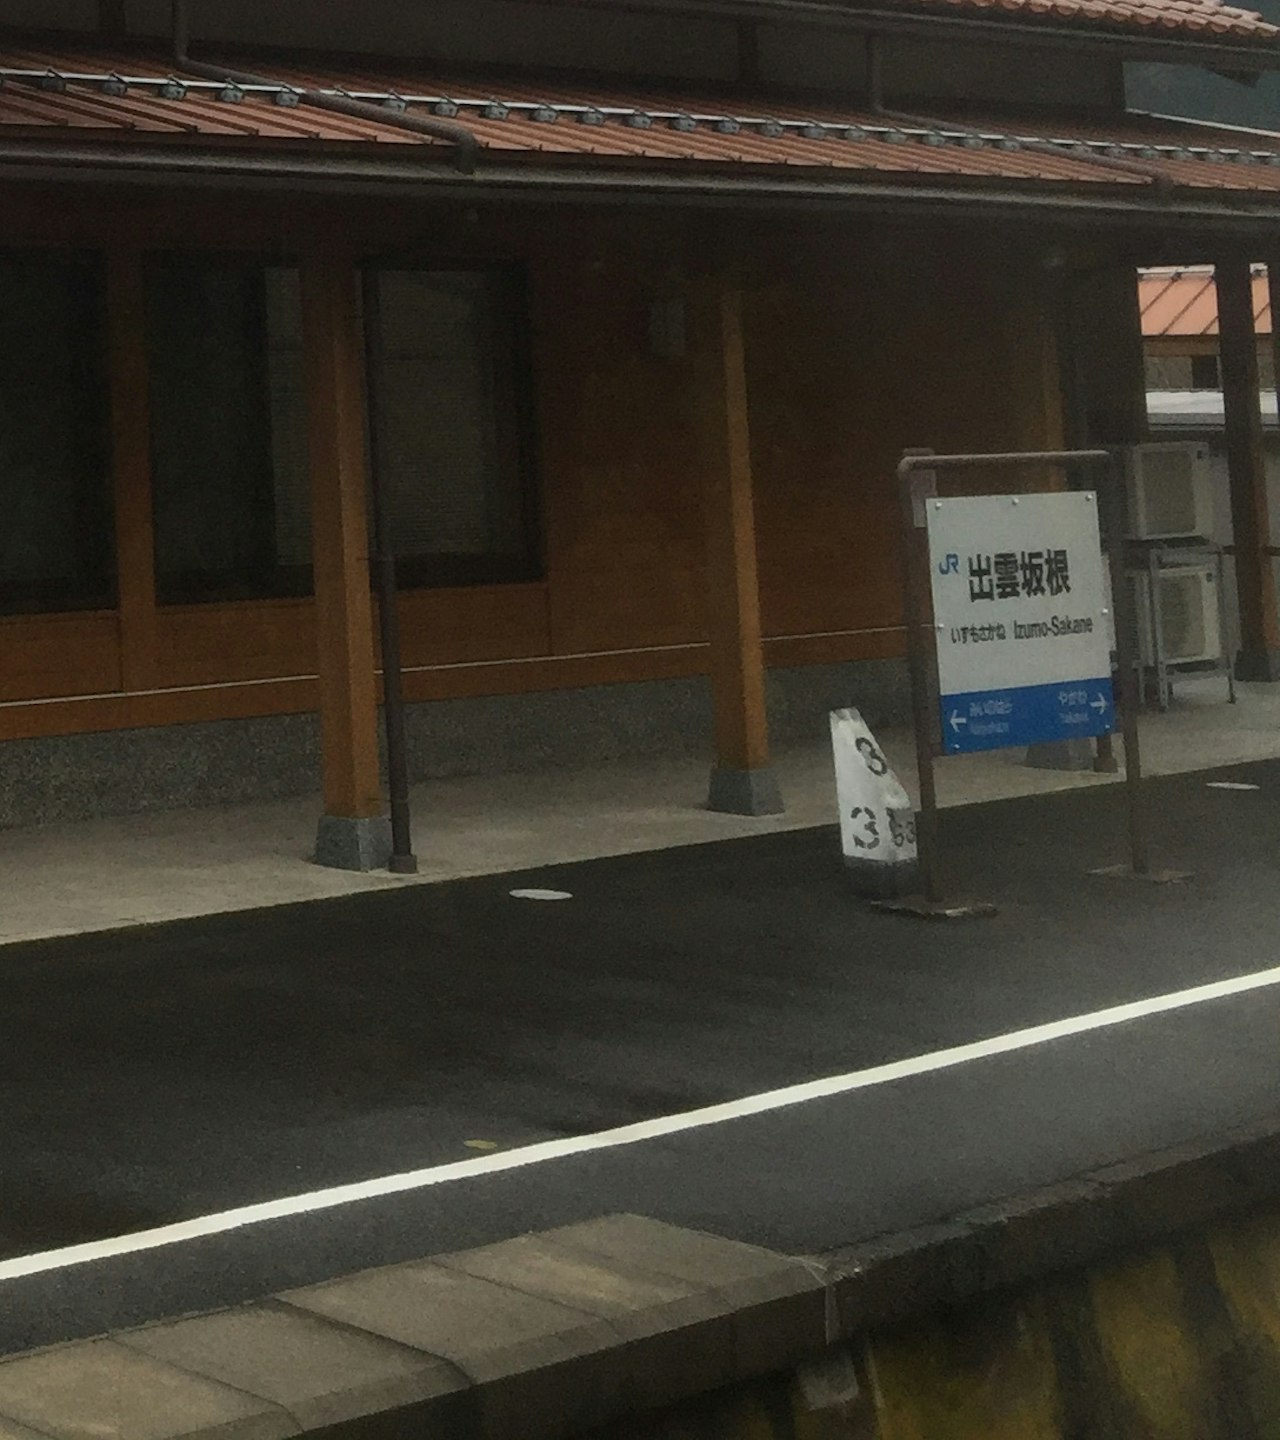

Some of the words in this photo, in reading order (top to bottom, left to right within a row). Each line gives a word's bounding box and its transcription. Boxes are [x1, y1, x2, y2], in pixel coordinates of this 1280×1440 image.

[938, 553, 959, 575] JR
[967, 549, 1072, 603] 出雲坂根
[1013, 615, 1093, 640] Izumo-Sakane
